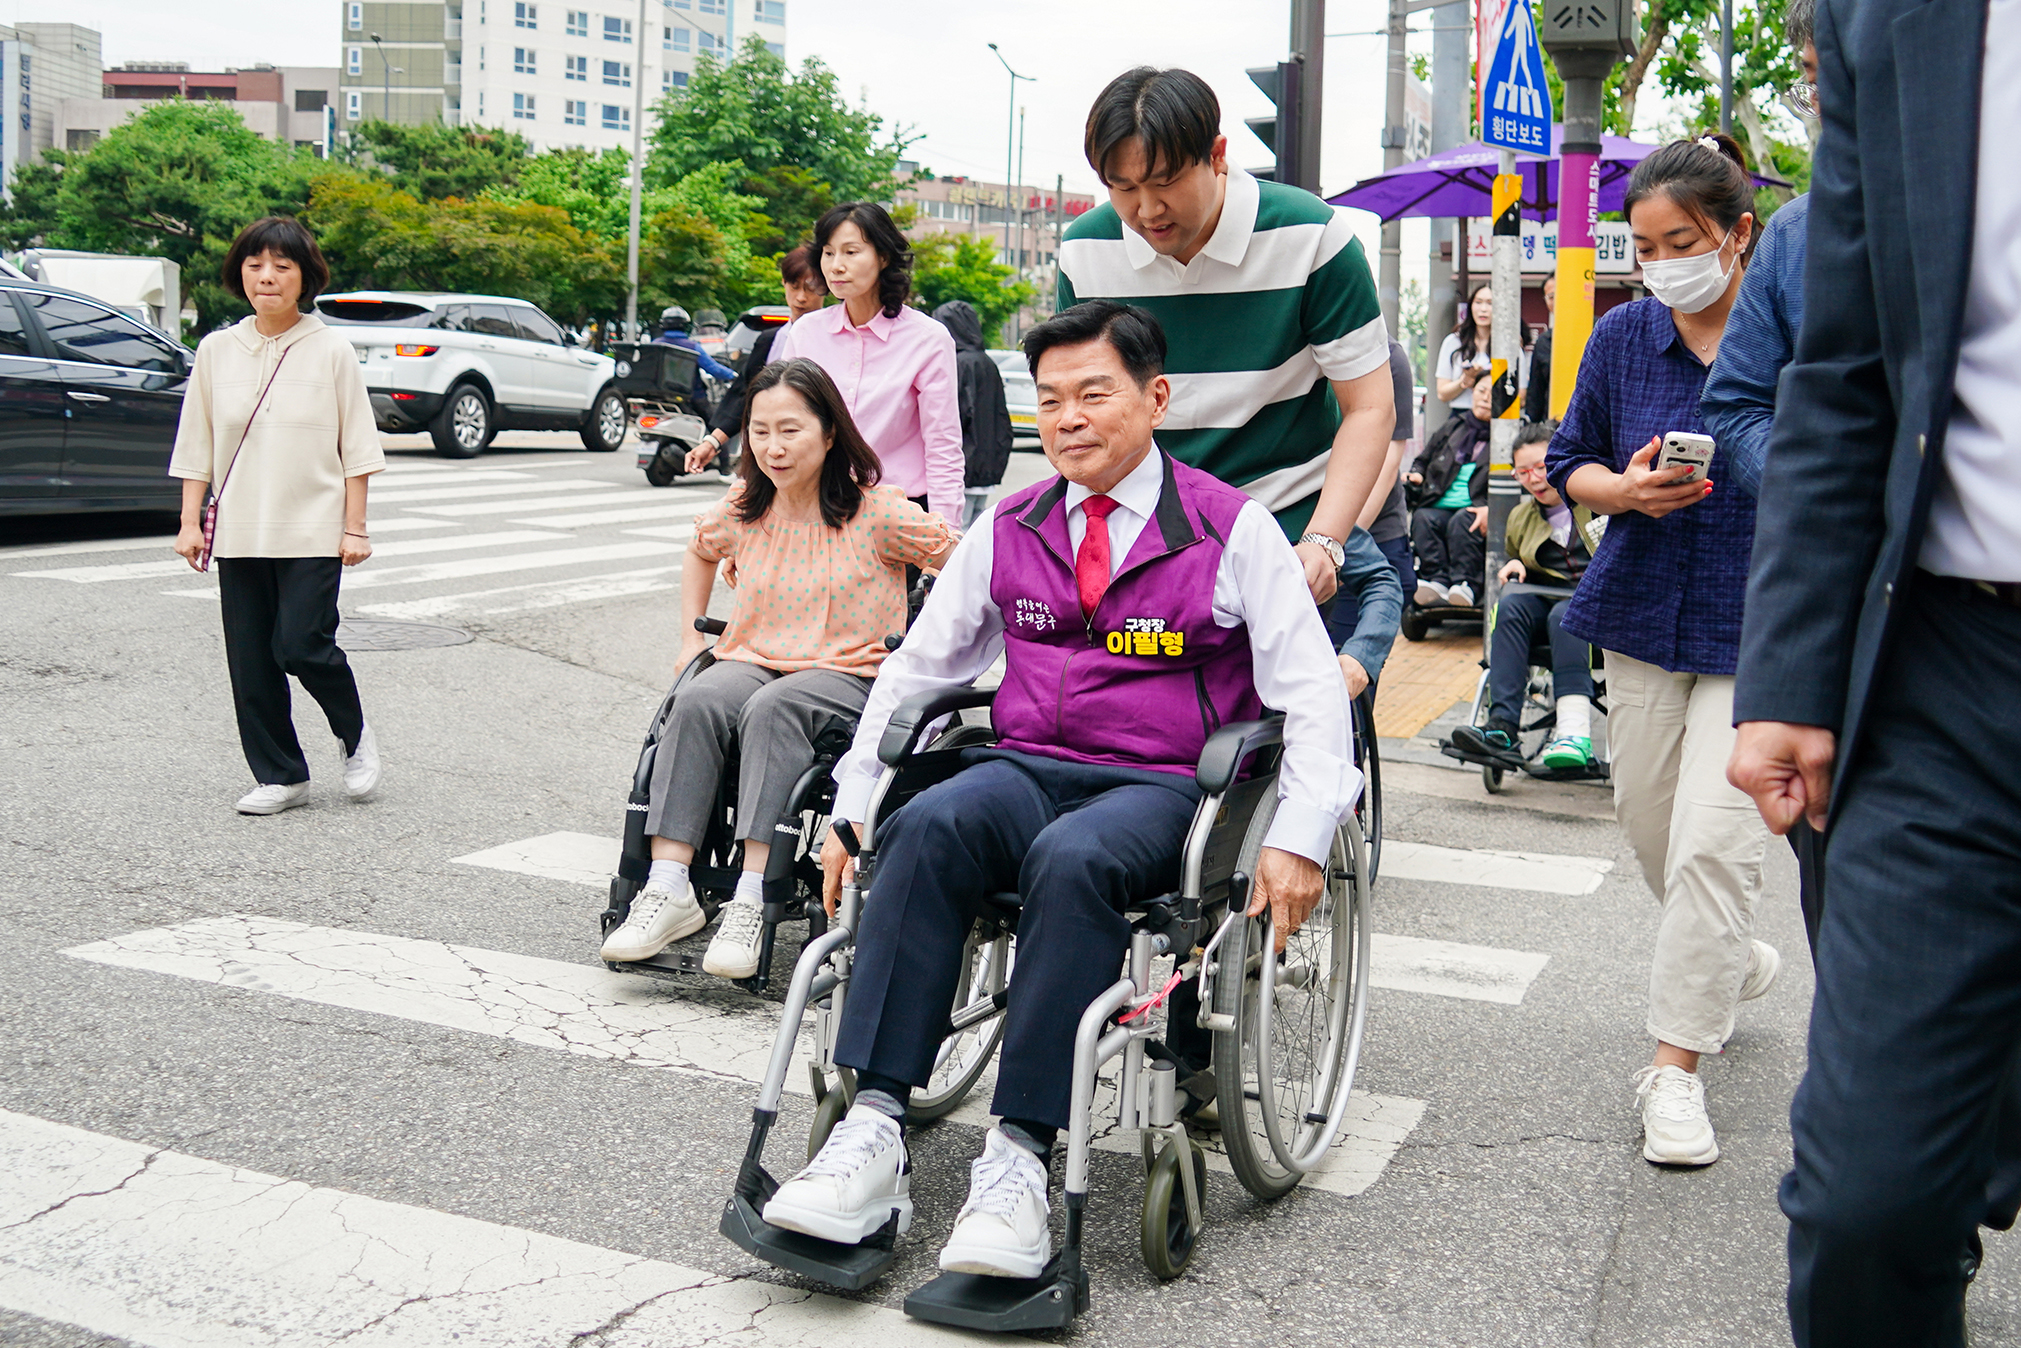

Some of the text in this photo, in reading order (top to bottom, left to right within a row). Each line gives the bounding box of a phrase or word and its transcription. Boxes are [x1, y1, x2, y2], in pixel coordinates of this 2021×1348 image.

[1492, 115, 1544, 146] 횡단보도
[1596, 234, 1627, 260] 김밥
[1015, 610, 1057, 631] 동대문구
[1125, 618, 1166, 632] 구청장
[1106, 631, 1184, 656] 이필형
[775, 823, 801, 836] ottoboc
